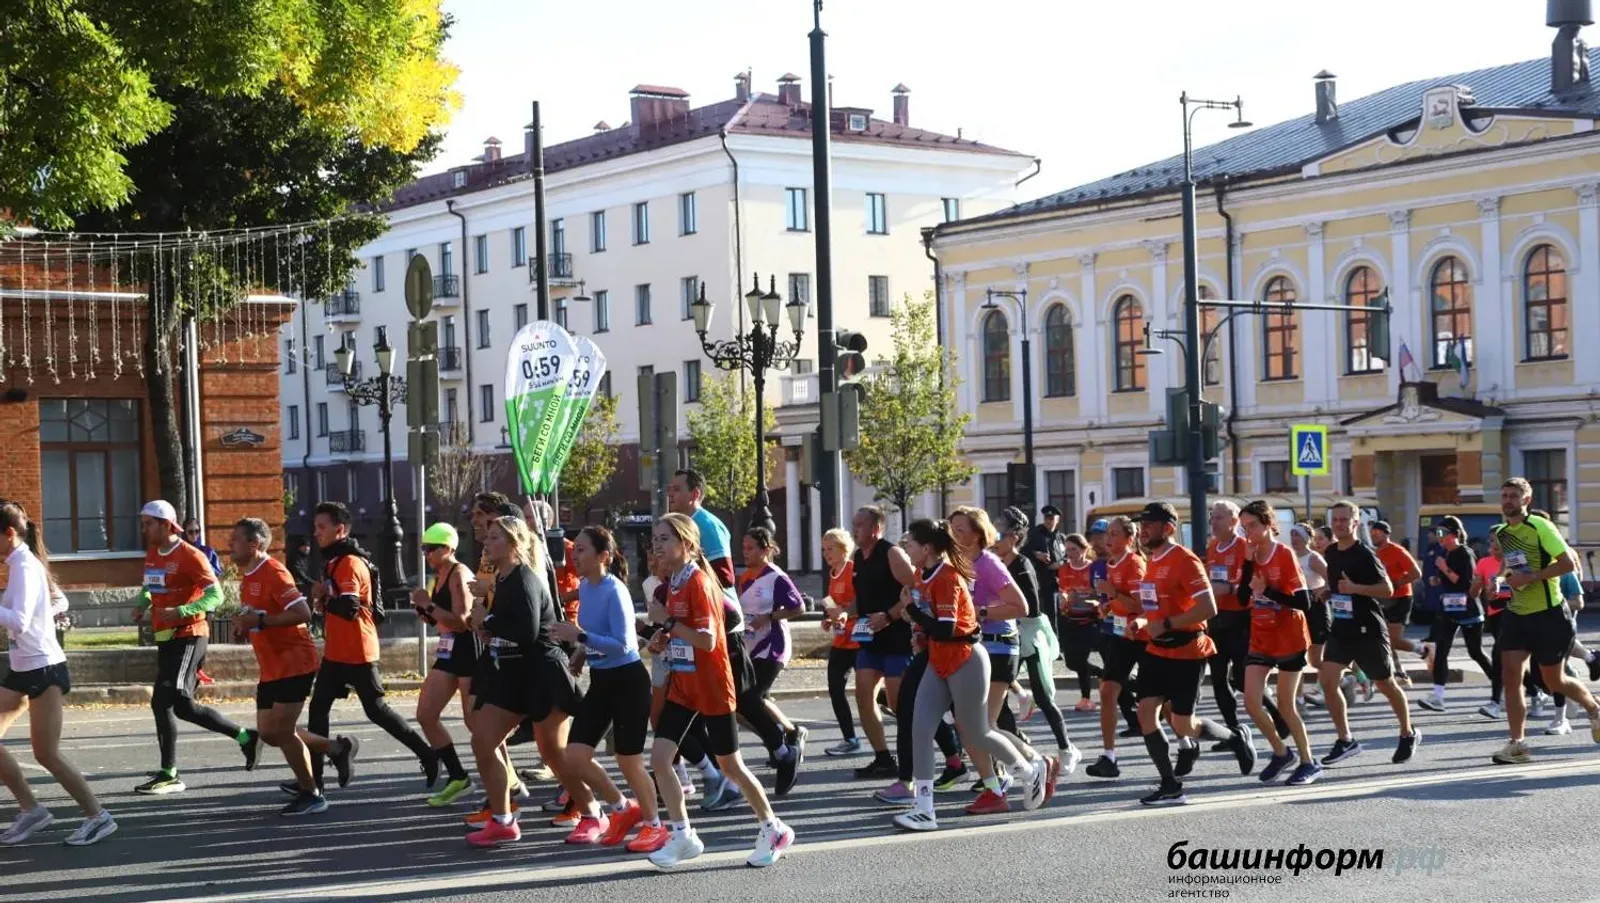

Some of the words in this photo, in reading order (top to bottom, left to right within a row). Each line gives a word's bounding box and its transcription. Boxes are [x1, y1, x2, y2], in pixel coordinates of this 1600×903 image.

[521, 340, 557, 353] SUUNTO
[522, 355, 560, 379] 0:59
[532, 438, 547, 464] БЕГИ
[541, 423, 551, 437] СО
[562, 430, 574, 446] СО
